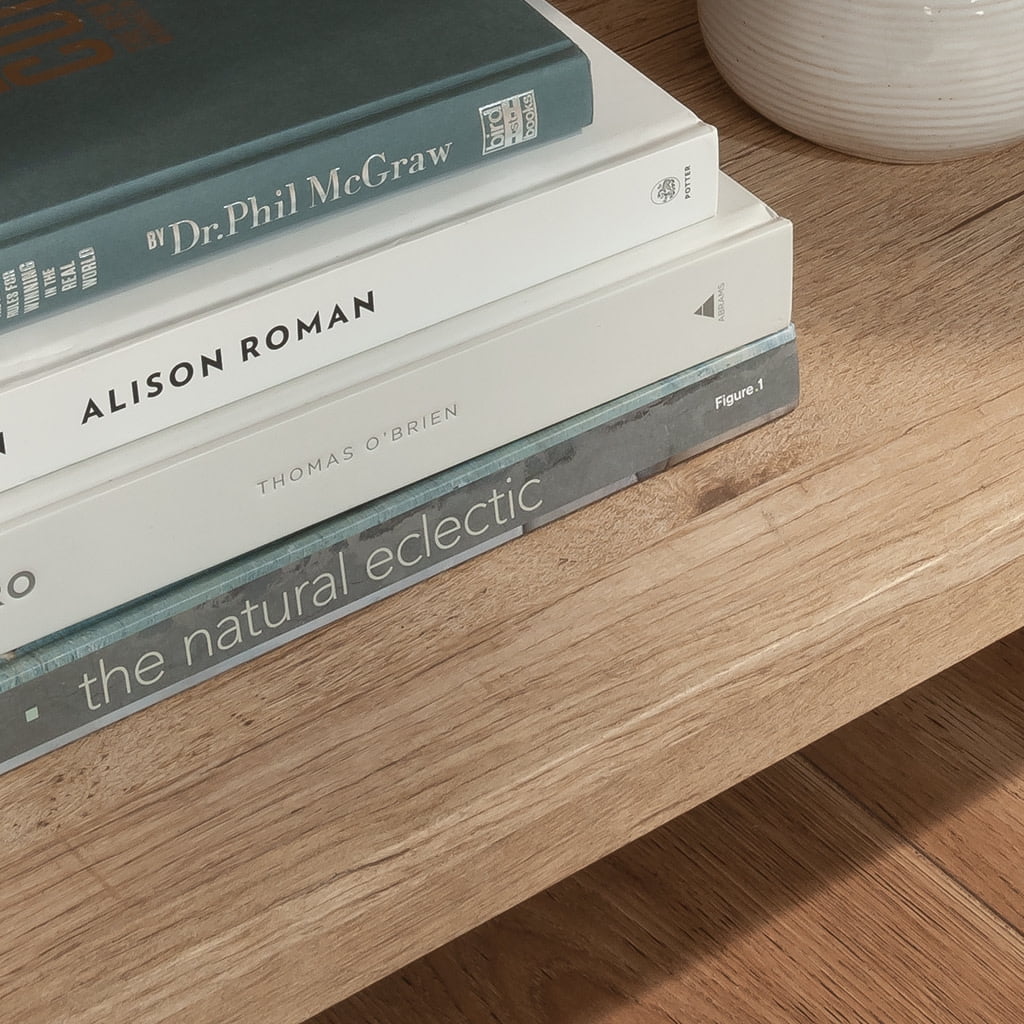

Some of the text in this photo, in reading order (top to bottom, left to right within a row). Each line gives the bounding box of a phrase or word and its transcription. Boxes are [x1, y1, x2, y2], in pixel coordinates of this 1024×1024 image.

[483, 106, 505, 152] bird
[522, 94, 535, 139] books
[146, 227, 165, 249] BY
[306, 142, 453, 209] McGraw
[19, 260, 40, 314] WINNING
[42, 266, 57, 298] IN THE
[60, 260, 77, 292] REAL
[78, 246, 98, 290] WORLD
[2, 269, 20, 319] RULES FOR
[717, 282, 725, 322] ABRAMS
[81, 290, 375, 425] ALISON ROMAN
[715, 378, 763, 410] Figure.1
[256, 404, 458, 495] THOMAS O'BRIEN
[78, 477, 543, 711] the natural eclectic
